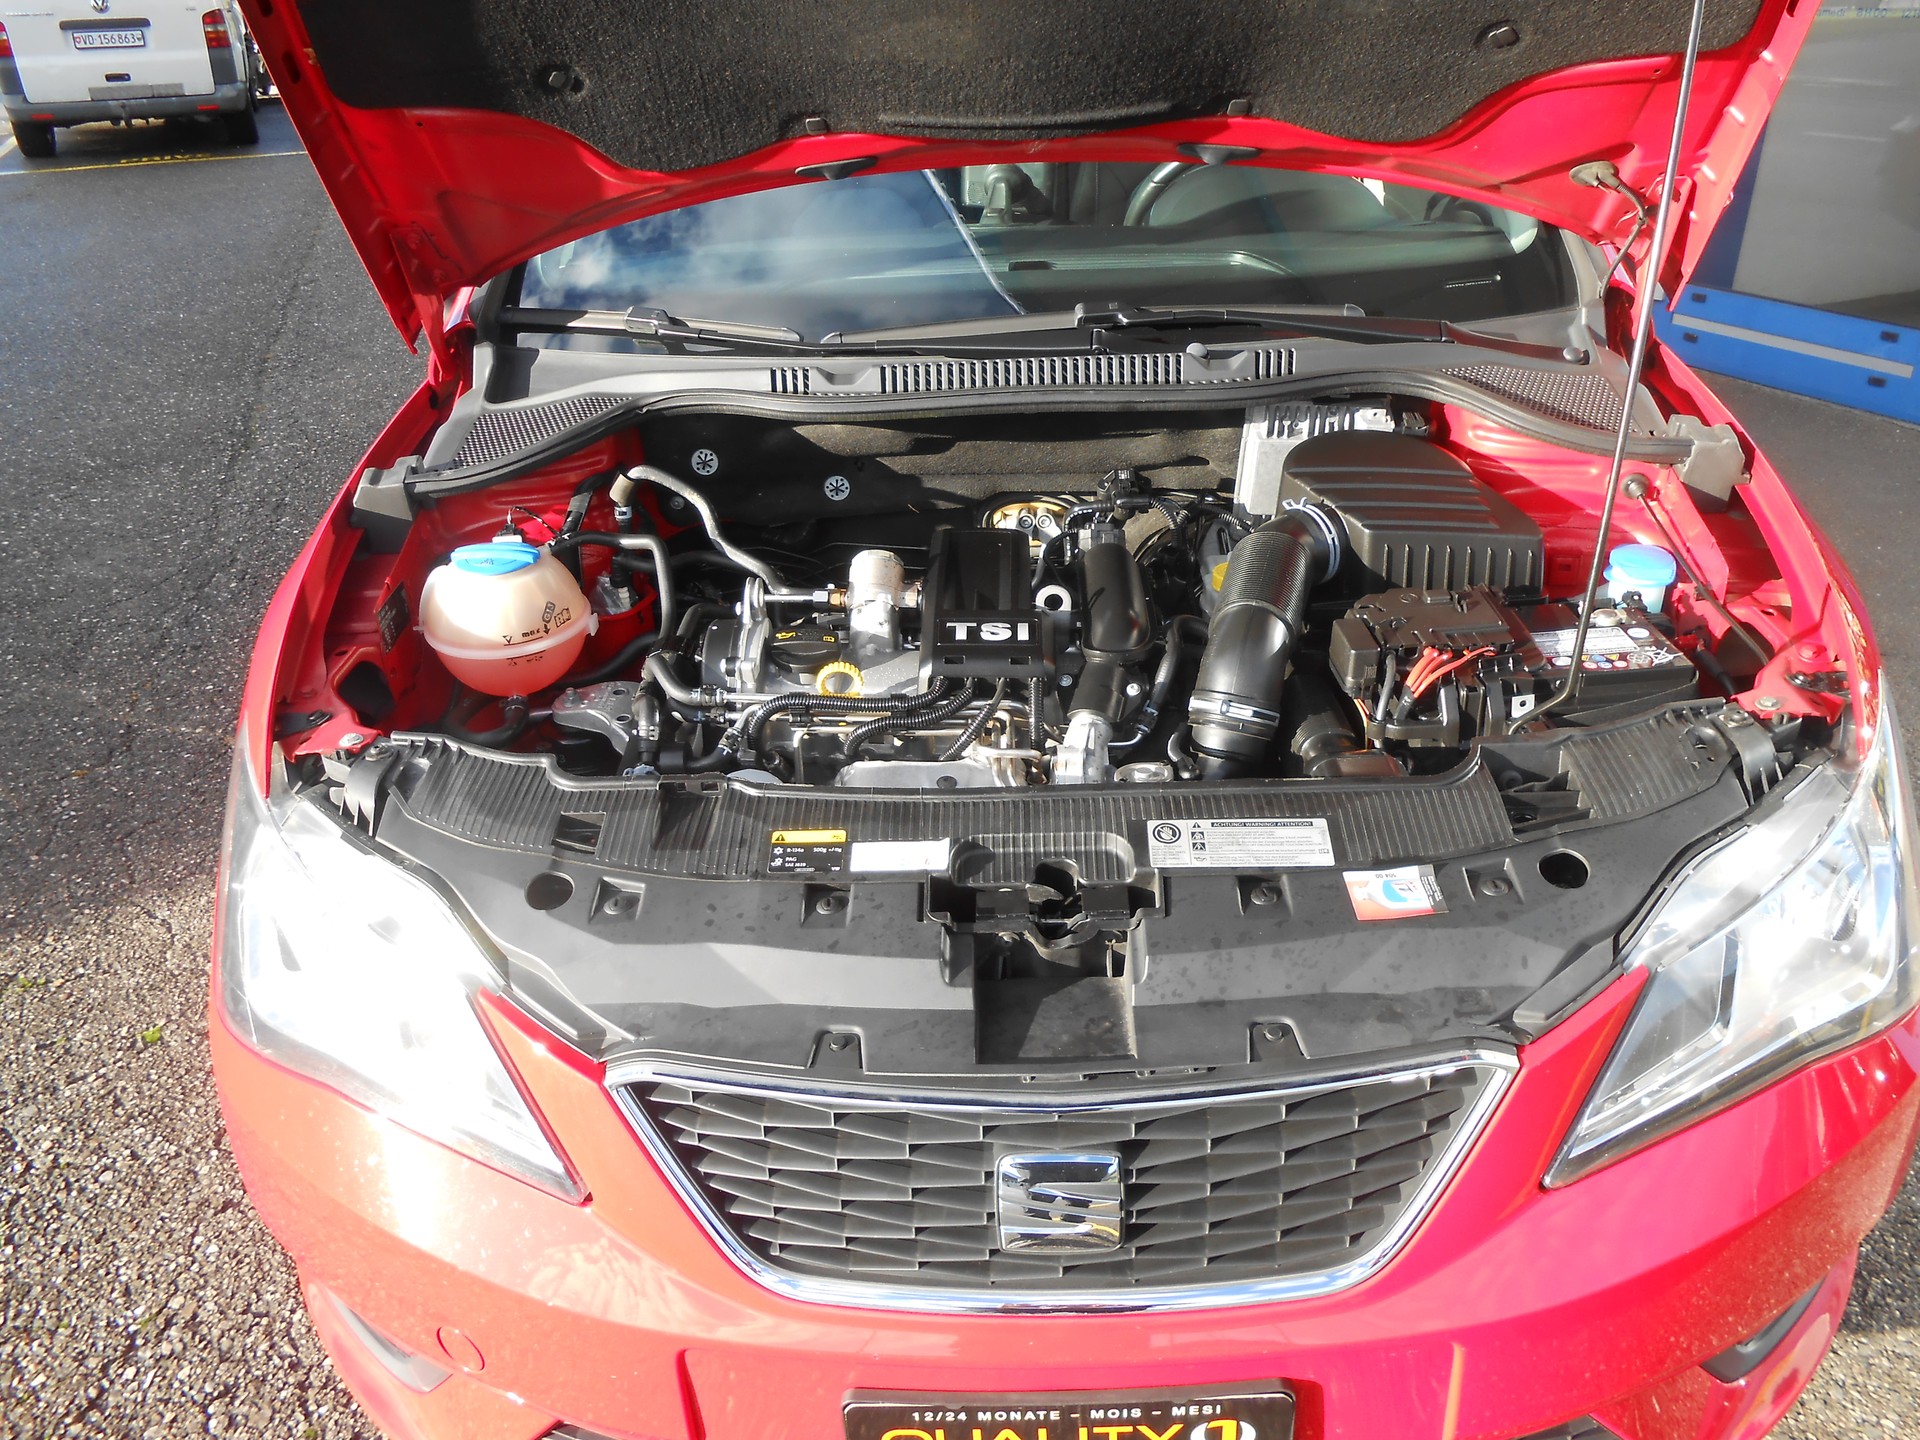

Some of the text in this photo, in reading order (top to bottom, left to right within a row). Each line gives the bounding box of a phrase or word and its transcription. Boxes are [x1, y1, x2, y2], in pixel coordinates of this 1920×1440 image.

[946, 622, 1029, 641] TSI
[911, 1411, 968, 1422] 12/24
[977, 1410, 1061, 1422] MONATE
[1089, 1407, 1142, 1420] MOIS
[1171, 1404, 1221, 1417] MESI
